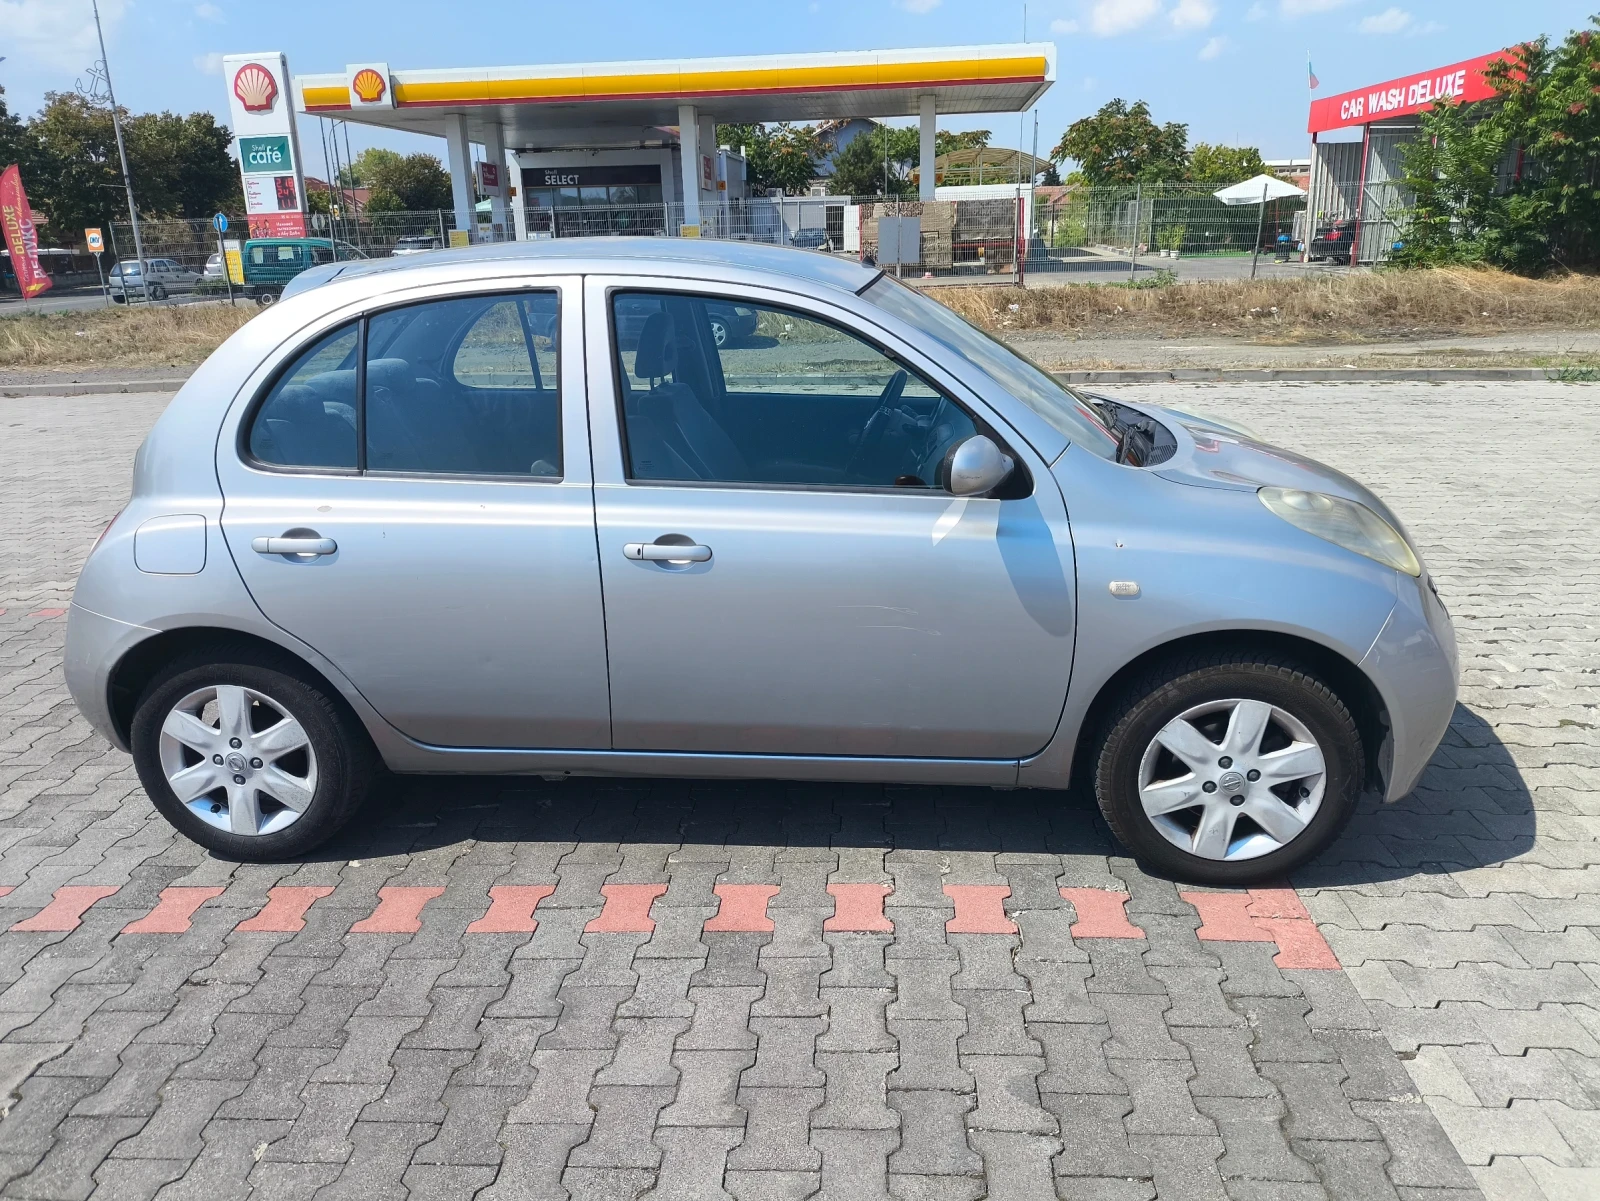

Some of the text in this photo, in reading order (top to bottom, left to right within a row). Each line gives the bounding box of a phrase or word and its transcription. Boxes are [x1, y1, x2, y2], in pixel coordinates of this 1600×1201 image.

[1340, 70, 1466, 120] CAR WASH DELUXE
[249, 145, 282, 165] café
[544, 174, 580, 185] SELECT
[3, 205, 25, 255] DELUXE
